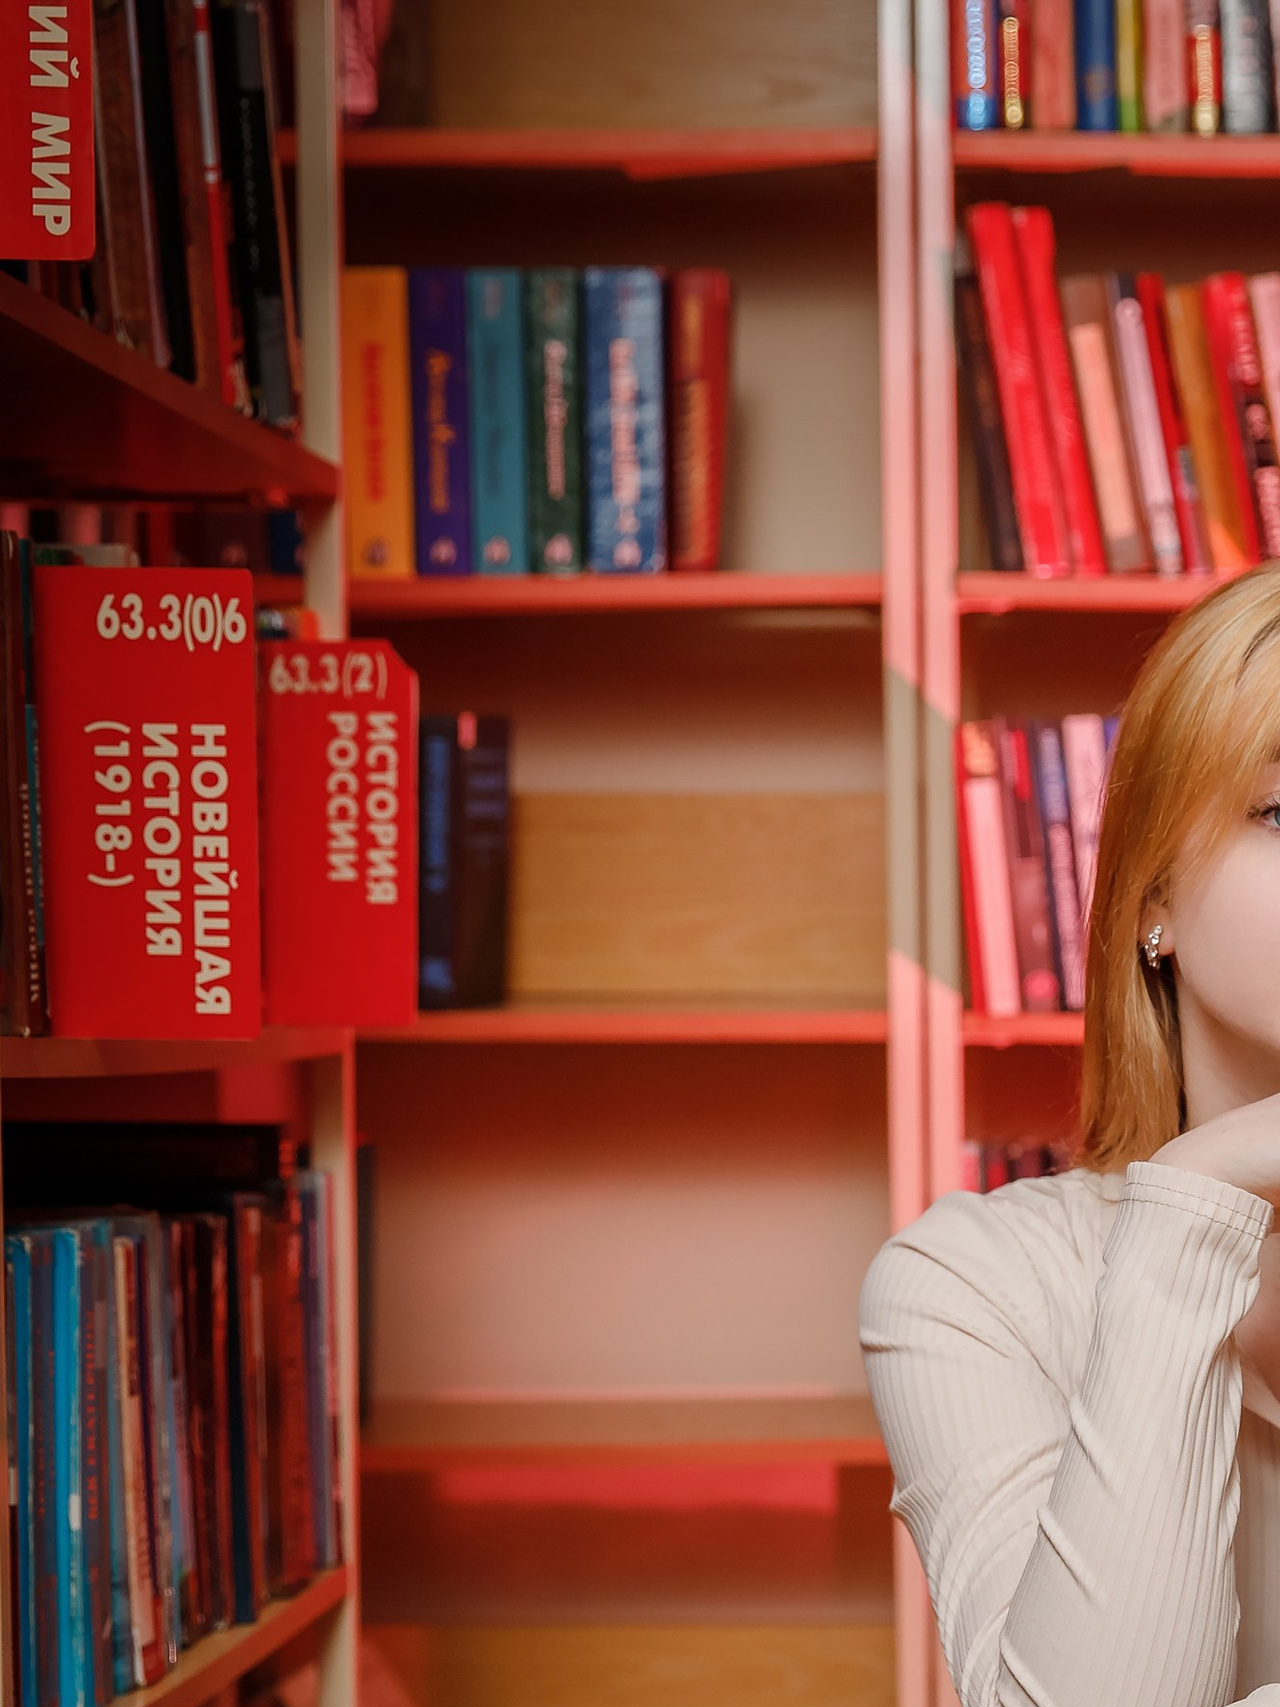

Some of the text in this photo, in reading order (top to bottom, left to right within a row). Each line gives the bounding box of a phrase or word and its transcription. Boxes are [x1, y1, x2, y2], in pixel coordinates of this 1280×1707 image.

[31, 112, 72, 236] МИР
[97, 593, 247, 651] 63.3(0)6
[268, 653, 388, 700] 63.3(2)
[84, 720, 135, 887] (1918-)
[142, 722, 183, 956] ИСТОРИЯ
[191, 723, 239, 1015] НОВЕЙШАЯ
[326, 712, 360, 882] РОССИИ
[364, 712, 400, 904] ИСТОРИЯ
